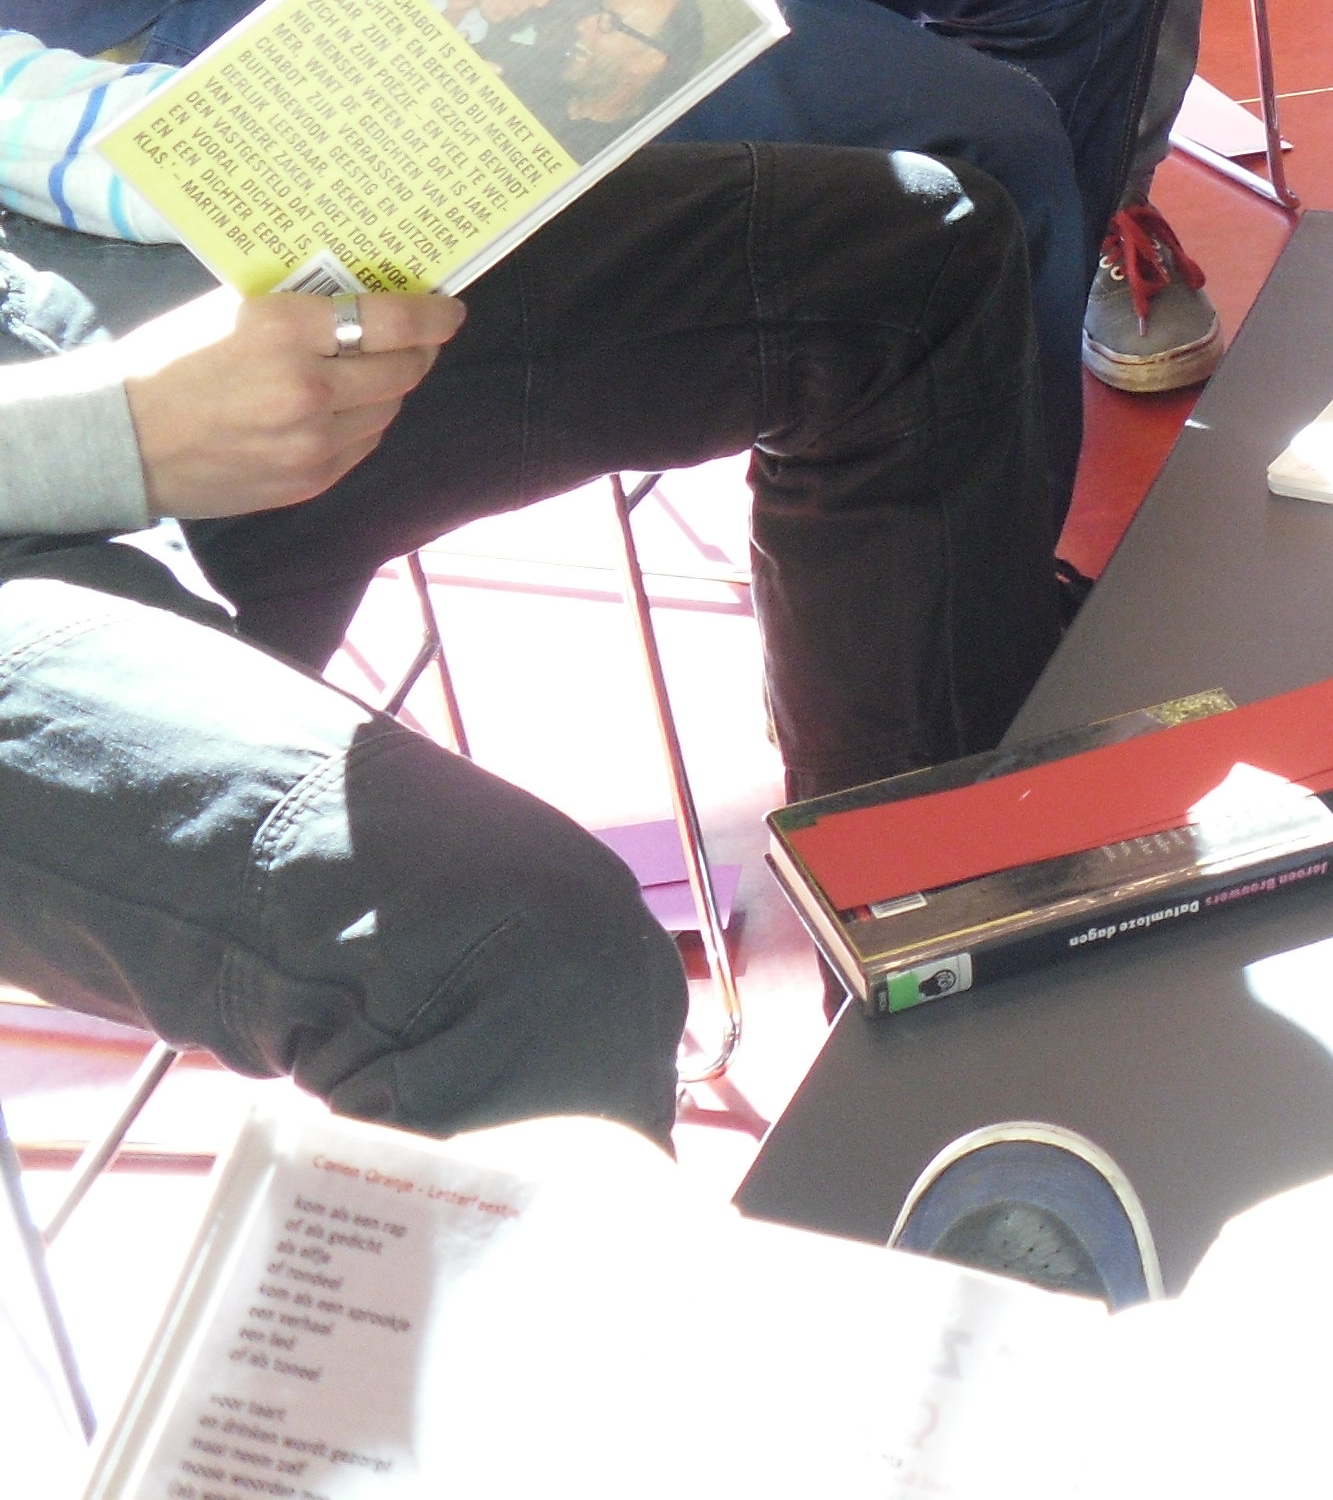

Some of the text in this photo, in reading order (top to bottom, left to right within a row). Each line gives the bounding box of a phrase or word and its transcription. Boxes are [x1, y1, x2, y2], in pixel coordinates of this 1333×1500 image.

[253, 35, 306, 88] CHABOT
[305, 90, 337, 121] ZIJN
[335, 122, 414, 203] VERRASSEND
[288, 9, 316, 35] NIG
[311, 33, 364, 87] MENSEN
[359, 85, 405, 130] WETEN
[425, 155, 452, 181] DAT
[448, 179, 468, 197] IS
[461, 194, 496, 227] JAM-
[303, 56, 343, 95] WANT
[338, 94, 362, 115] DE
[357, 113, 424, 181] GEDICHTEN
[418, 179, 449, 208] VAN
[443, 205, 479, 240] BART
[333, 26, 353, 43] IN
[349, 42, 378, 69] ZIJN
[373, 68, 417, 112] POËZIE
[421, 119, 443, 139] EN
[438, 137, 470, 169] VEEL
[465, 166, 486, 185] TE
[480, 182, 513, 214] WEI-
[360, 22, 391, 52] ZIJN
[389, 53, 431, 95] ECHTE
[428, 96, 480, 147] GEZICHT
[477, 148, 529, 201] BEVINDT
[404, 37, 428, 59] EN
[420, 55, 471, 106] BEKEND
[464, 103, 487, 124] BIJ
[437, 42, 456, 59] IS
[453, 58, 480, 85] EEN
[476, 84, 509, 116] MAN
[505, 115, 533, 142] MET
[530, 142, 562, 174] VELE
[149, 116, 300, 269] EN EEN DICHTER EERSTE
[167, 103, 191, 125] EN
[189, 126, 241, 177] VOORAL
[238, 177, 295, 233] DICHTER
[179, 179, 231, 228] MARTIN
[224, 225, 258, 256] BRIL
[184, 89, 390, 293] DEN VASTGESTELD DAT CHABOT EER
[201, 76, 233, 105] VAN
[227, 102, 278, 152] ANDERE
[313, 192, 351, 228] MOET
[344, 225, 382, 261] TOCH
[375, 257, 413, 294] WOR-
[326, 144, 379, 197] GEESTIG
[375, 196, 398, 217] EN
[395, 217, 446, 267] UITZON-
[329, 178, 379, 227] BEKEND
[375, 226, 405, 255] VAN
[401, 254, 429, 280] TAL
[1069, 861, 1328, 947] Jeroen Brouwers Datumloze dagen
